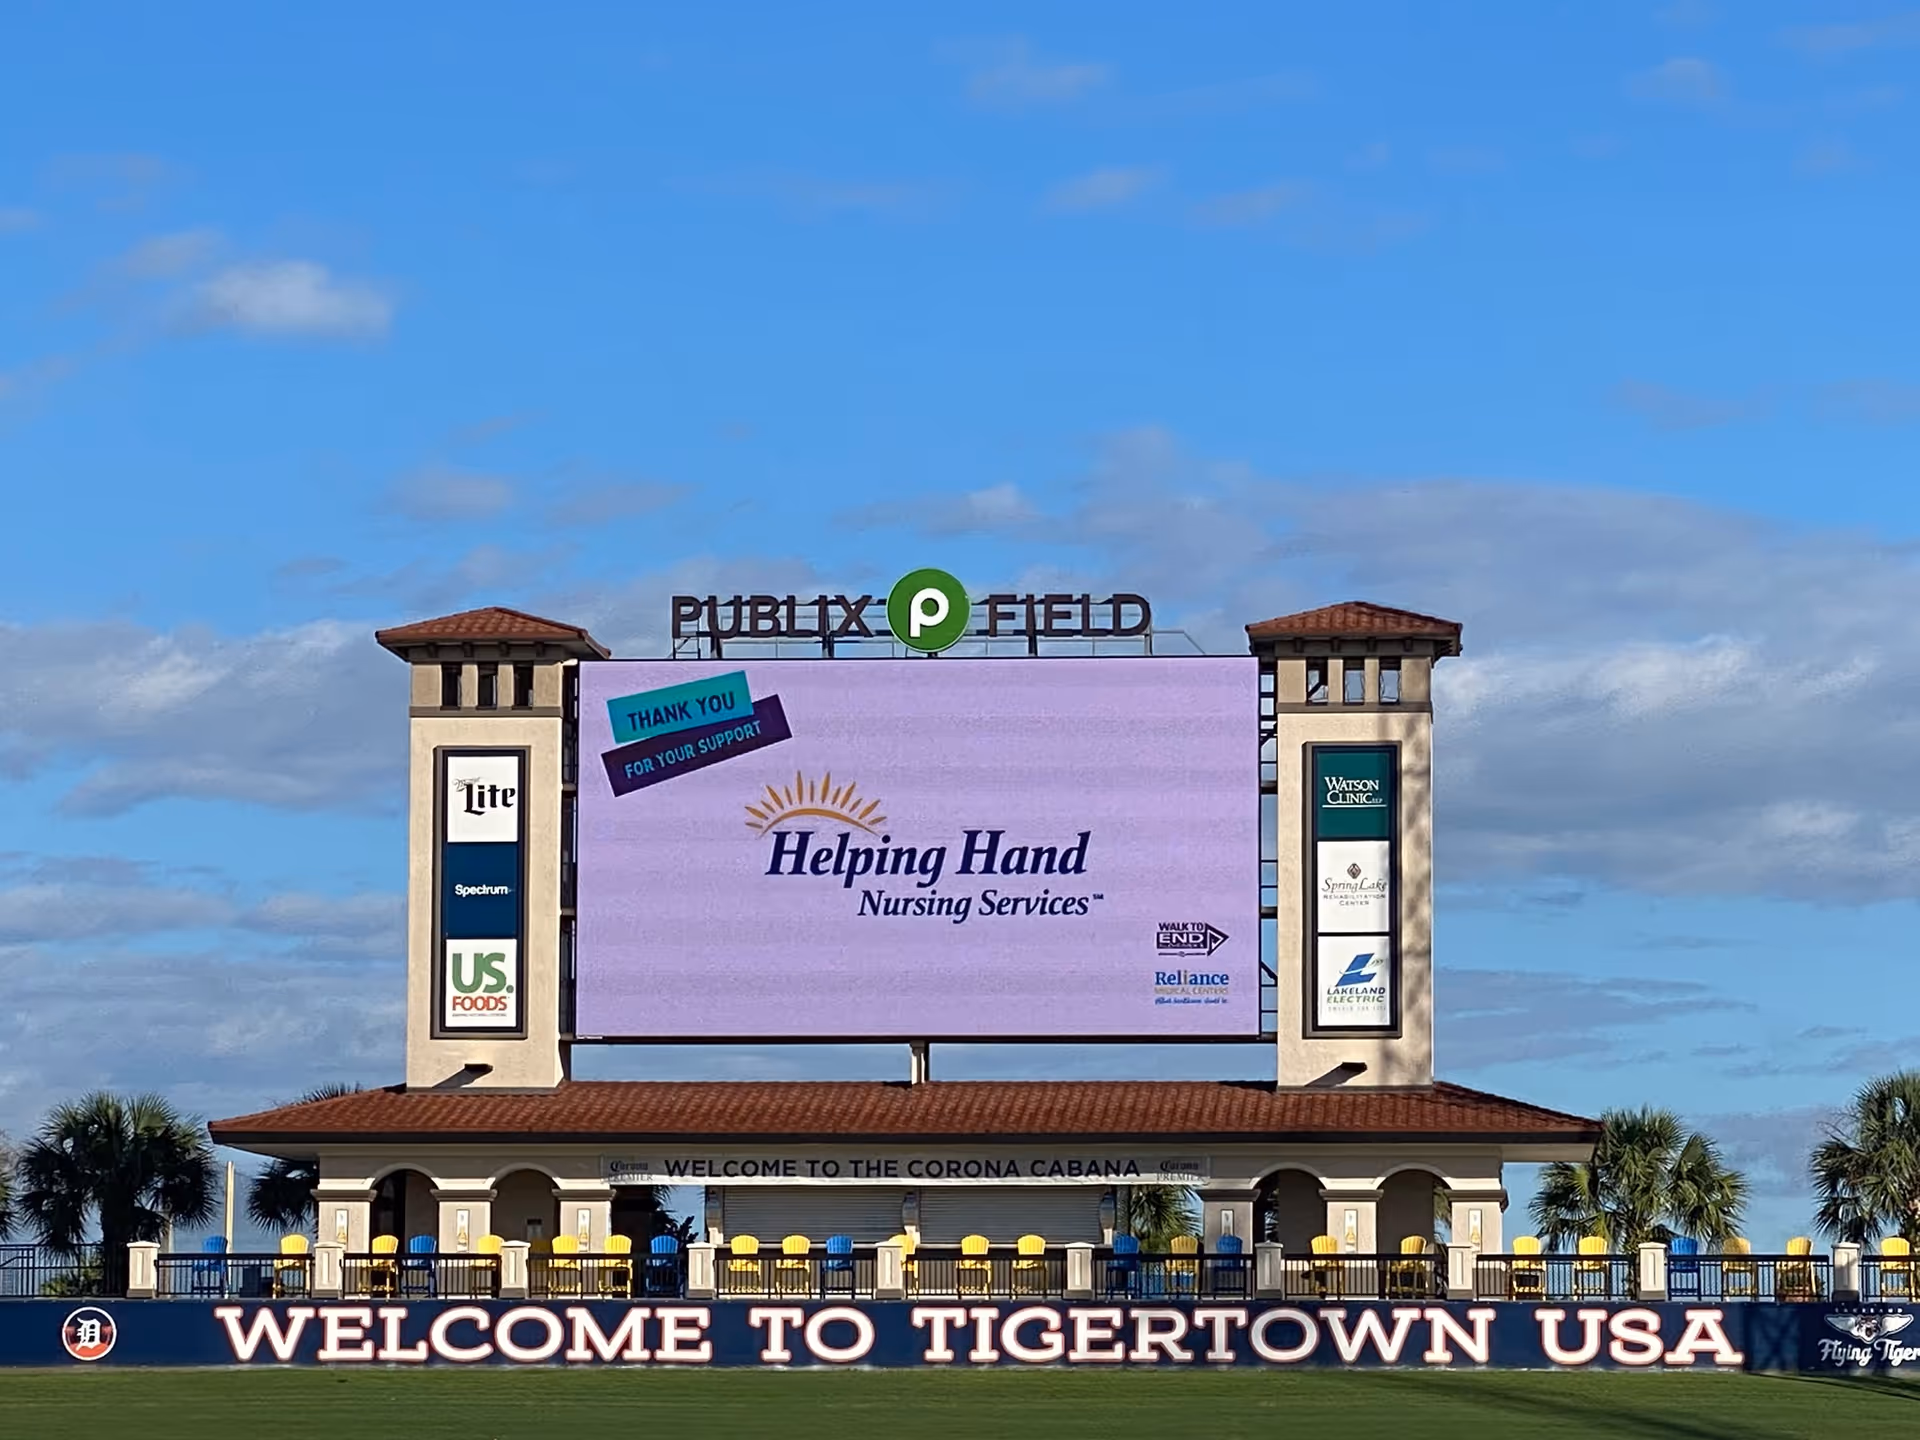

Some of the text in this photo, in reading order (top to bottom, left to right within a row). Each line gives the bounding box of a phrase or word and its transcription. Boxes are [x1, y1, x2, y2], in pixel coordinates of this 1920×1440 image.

[672, 594, 875, 638] PUBLIX
[987, 594, 1151, 637] FIELD
[627, 691, 736, 732] THANK YOU
[624, 720, 762, 779] FOR YOUR SUPPORT
[1324, 776, 1380, 791] WATSON
[464, 783, 517, 816] Lite
[1327, 790, 1373, 804] CLINIC
[764, 829, 1092, 889] Helping Hand
[455, 883, 509, 898] Spectrum
[857, 889, 972, 924] Nursing
[978, 889, 1089, 916] Services
[1158, 922, 1204, 932] WALK TO
[1159, 933, 1204, 944] END
[1154, 970, 1230, 986] Reliance
[1327, 986, 1387, 996] LAKELAND
[1327, 995, 1385, 1004] ELECTRIC
[452, 996, 508, 1011] FOODS
[664, 1159, 1141, 1178] WELCOME TO THE CORONA CABANA
[214, 1306, 1745, 1365] WELCOME TO TIGERTOWN USA
[1817, 1338, 1873, 1367] Flying
